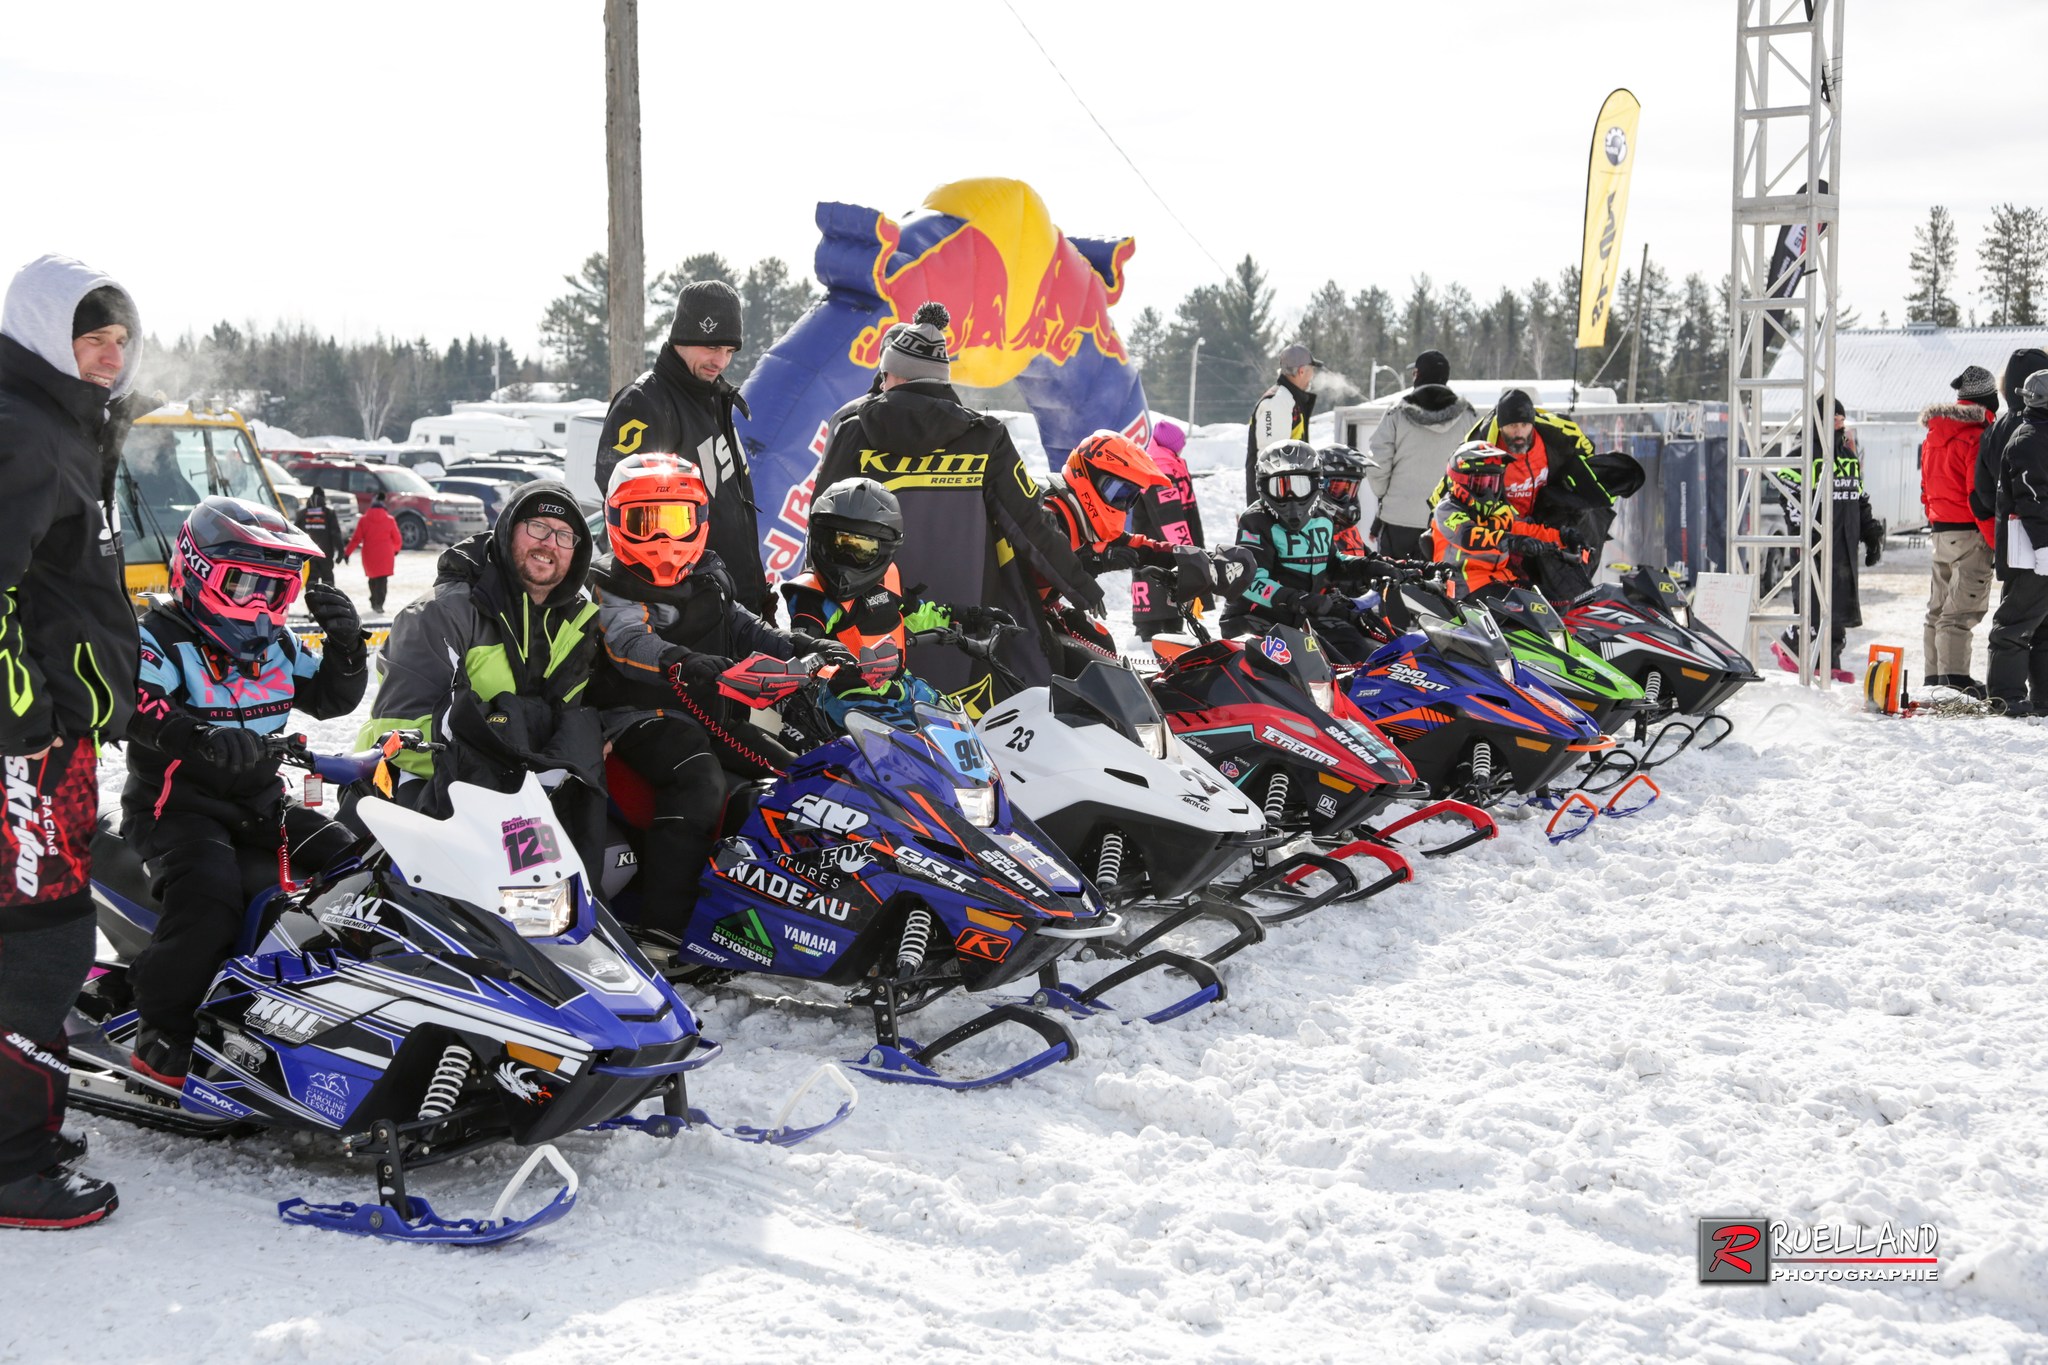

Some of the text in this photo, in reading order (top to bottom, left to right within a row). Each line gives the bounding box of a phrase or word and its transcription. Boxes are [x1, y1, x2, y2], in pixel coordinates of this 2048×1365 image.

[930, 476, 984, 484] RACE SP
[1081, 492, 1099, 518] FXR
[1286, 526, 1330, 556] FXR
[1469, 526, 1505, 548] FX
[180, 537, 212, 580] FXR
[1485, 618, 1497, 639] 4
[1582, 605, 1646, 625] ZR
[1265, 635, 1286, 657] VP
[1387, 663, 1428, 679] SNO
[1387, 672, 1450, 692] SCOOT
[1005, 726, 1035, 752] 23
[1325, 725, 1378, 765] ski-doo
[1182, 797, 1210, 813] ARCTIC CAT
[42, 795, 59, 856] RACING
[502, 817, 542, 834] BOISVERT
[505, 824, 562, 873] 129
[820, 839, 878, 873] FOX
[992, 850, 1018, 868] SNO
[894, 845, 976, 884] GRT
[895, 857, 967, 893] SUSPENSION
[977, 850, 1050, 898] SCOOT
[727, 861, 851, 921] NADEAU
[342, 894, 381, 923] KL
[711, 932, 773, 967] ST-JOSEPH
[714, 925, 774, 959] STRUCTURES
[784, 925, 837, 955] YAMAHA
[5, 1032, 71, 1075] ski-doo
[305, 1097, 345, 1120] LESSARD
[306, 1090, 346, 1113] CAROLINE
[307, 1085, 348, 1107] DISTRIBUTION
